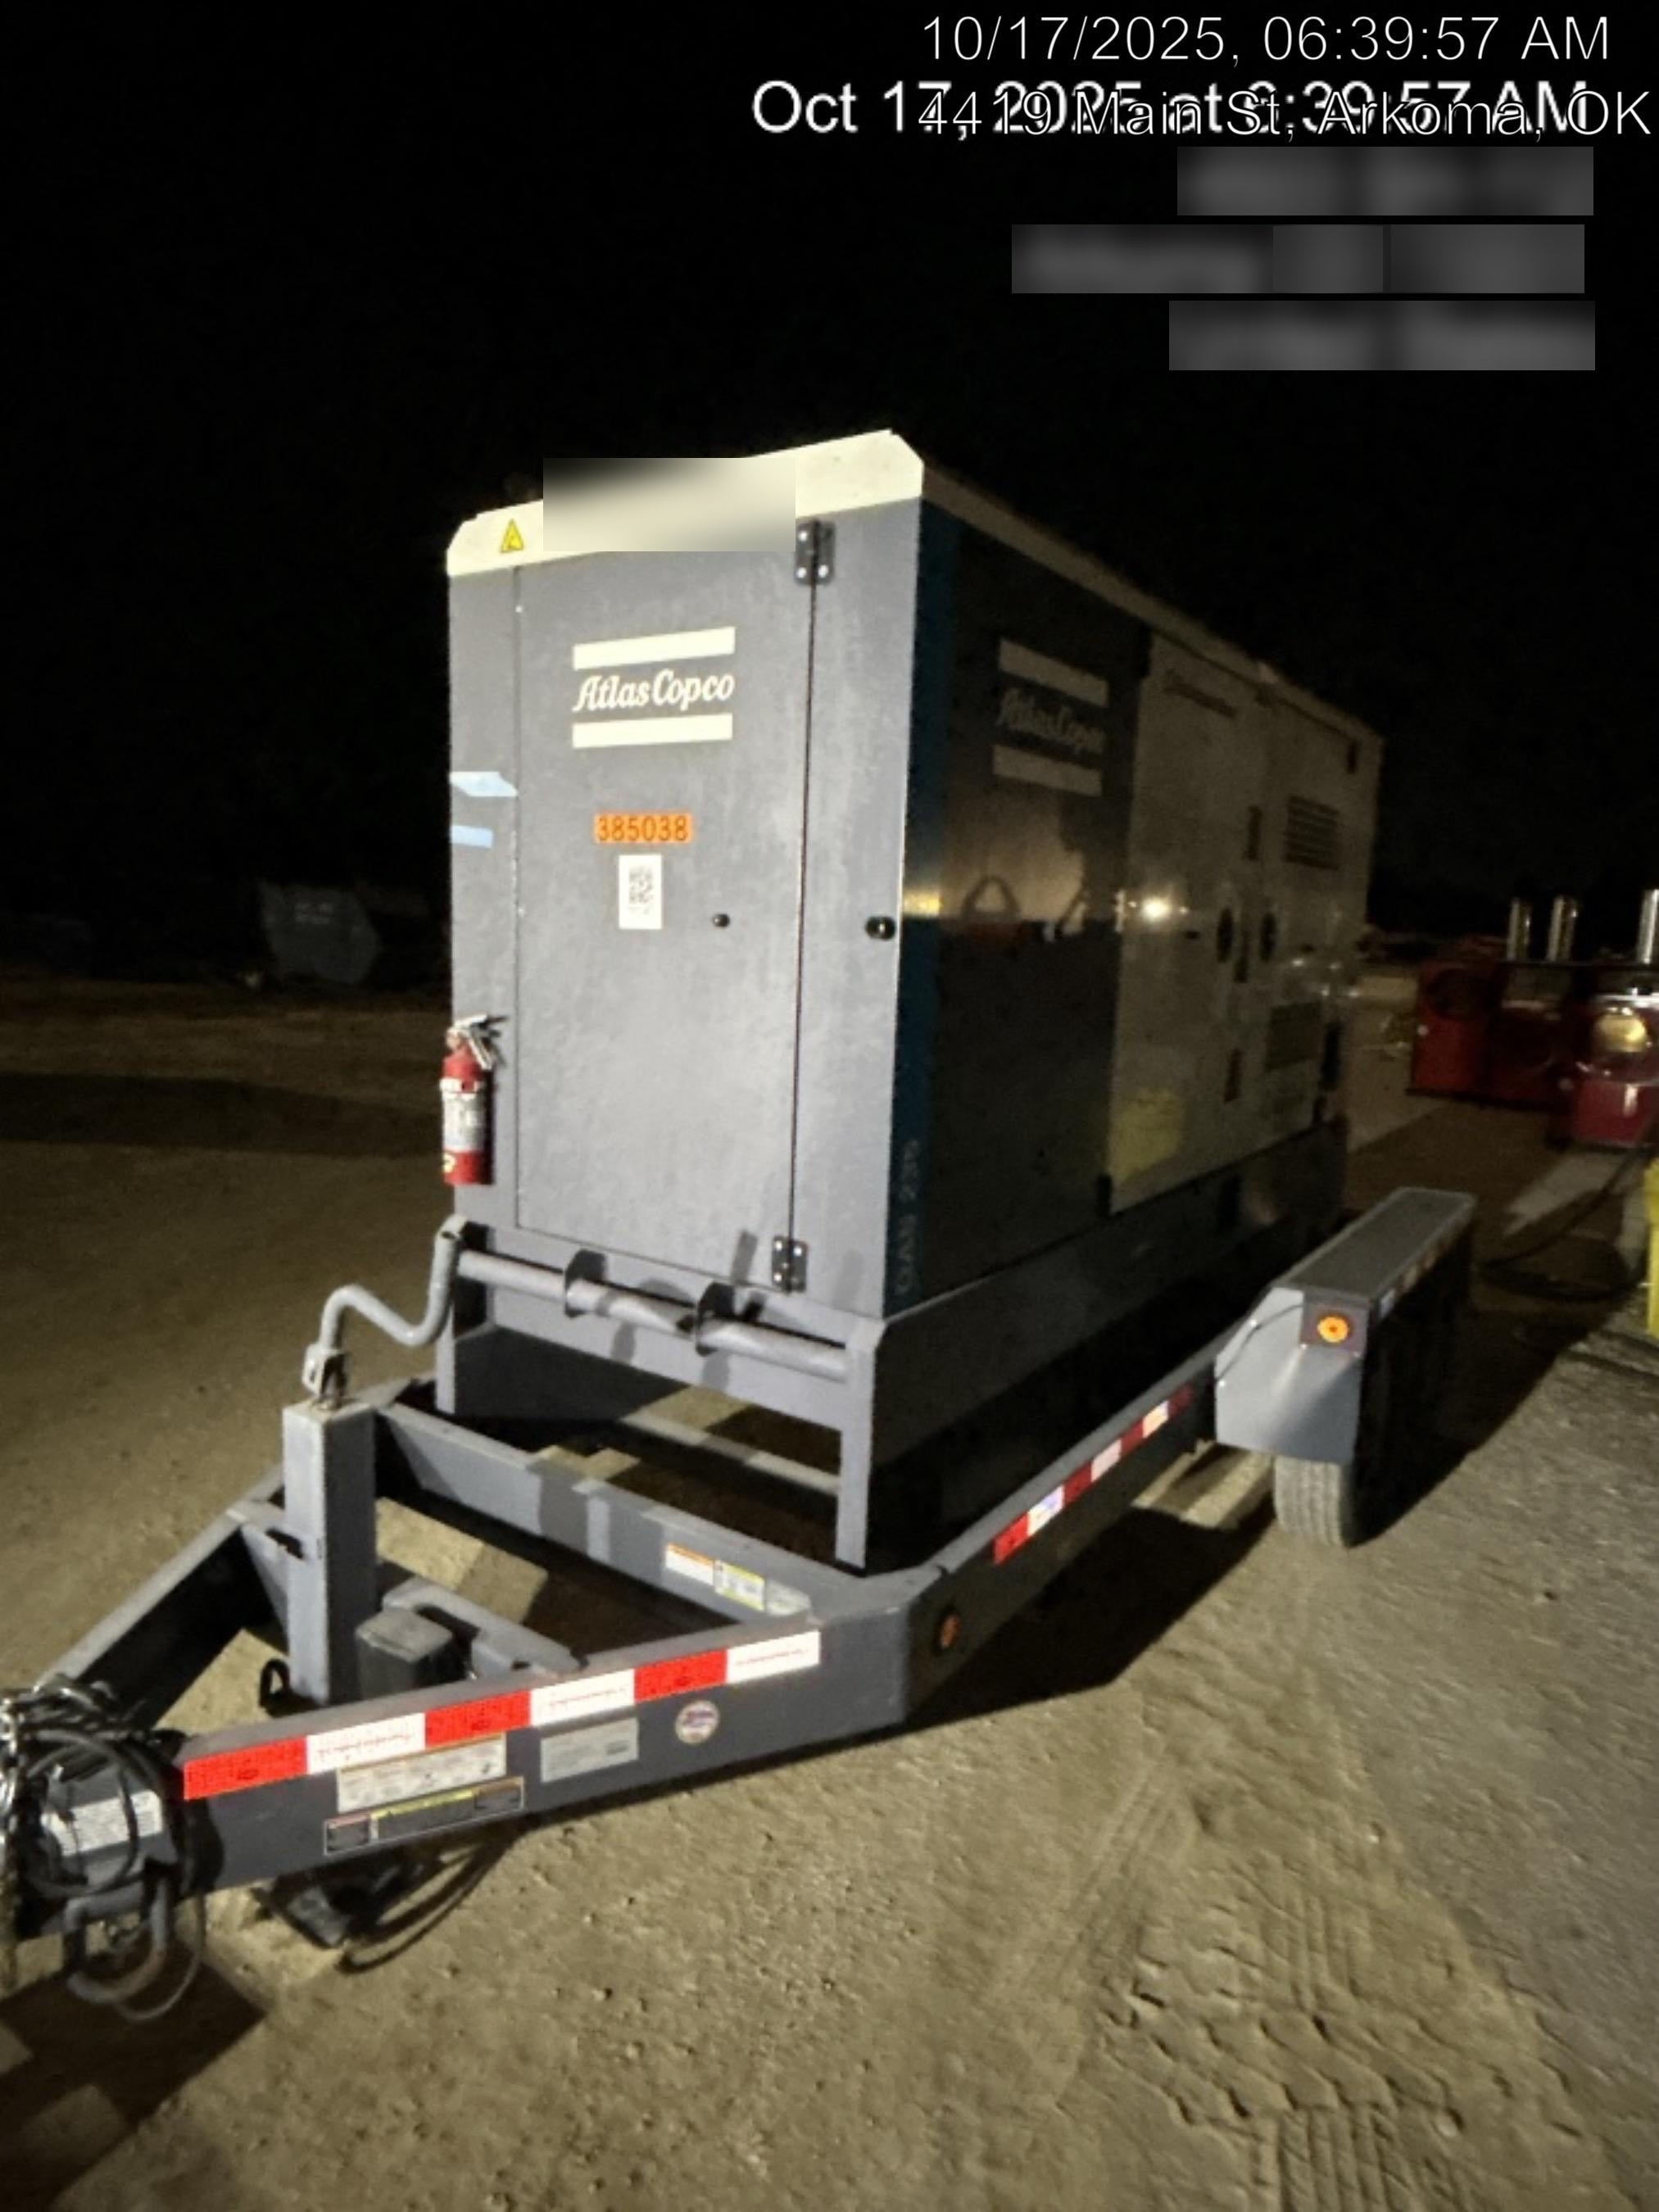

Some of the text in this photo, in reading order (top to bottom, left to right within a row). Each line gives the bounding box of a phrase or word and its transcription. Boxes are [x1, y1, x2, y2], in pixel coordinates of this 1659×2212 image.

[572, 668, 737, 712] Atlas Copco
[597, 814, 690, 842] 385038
